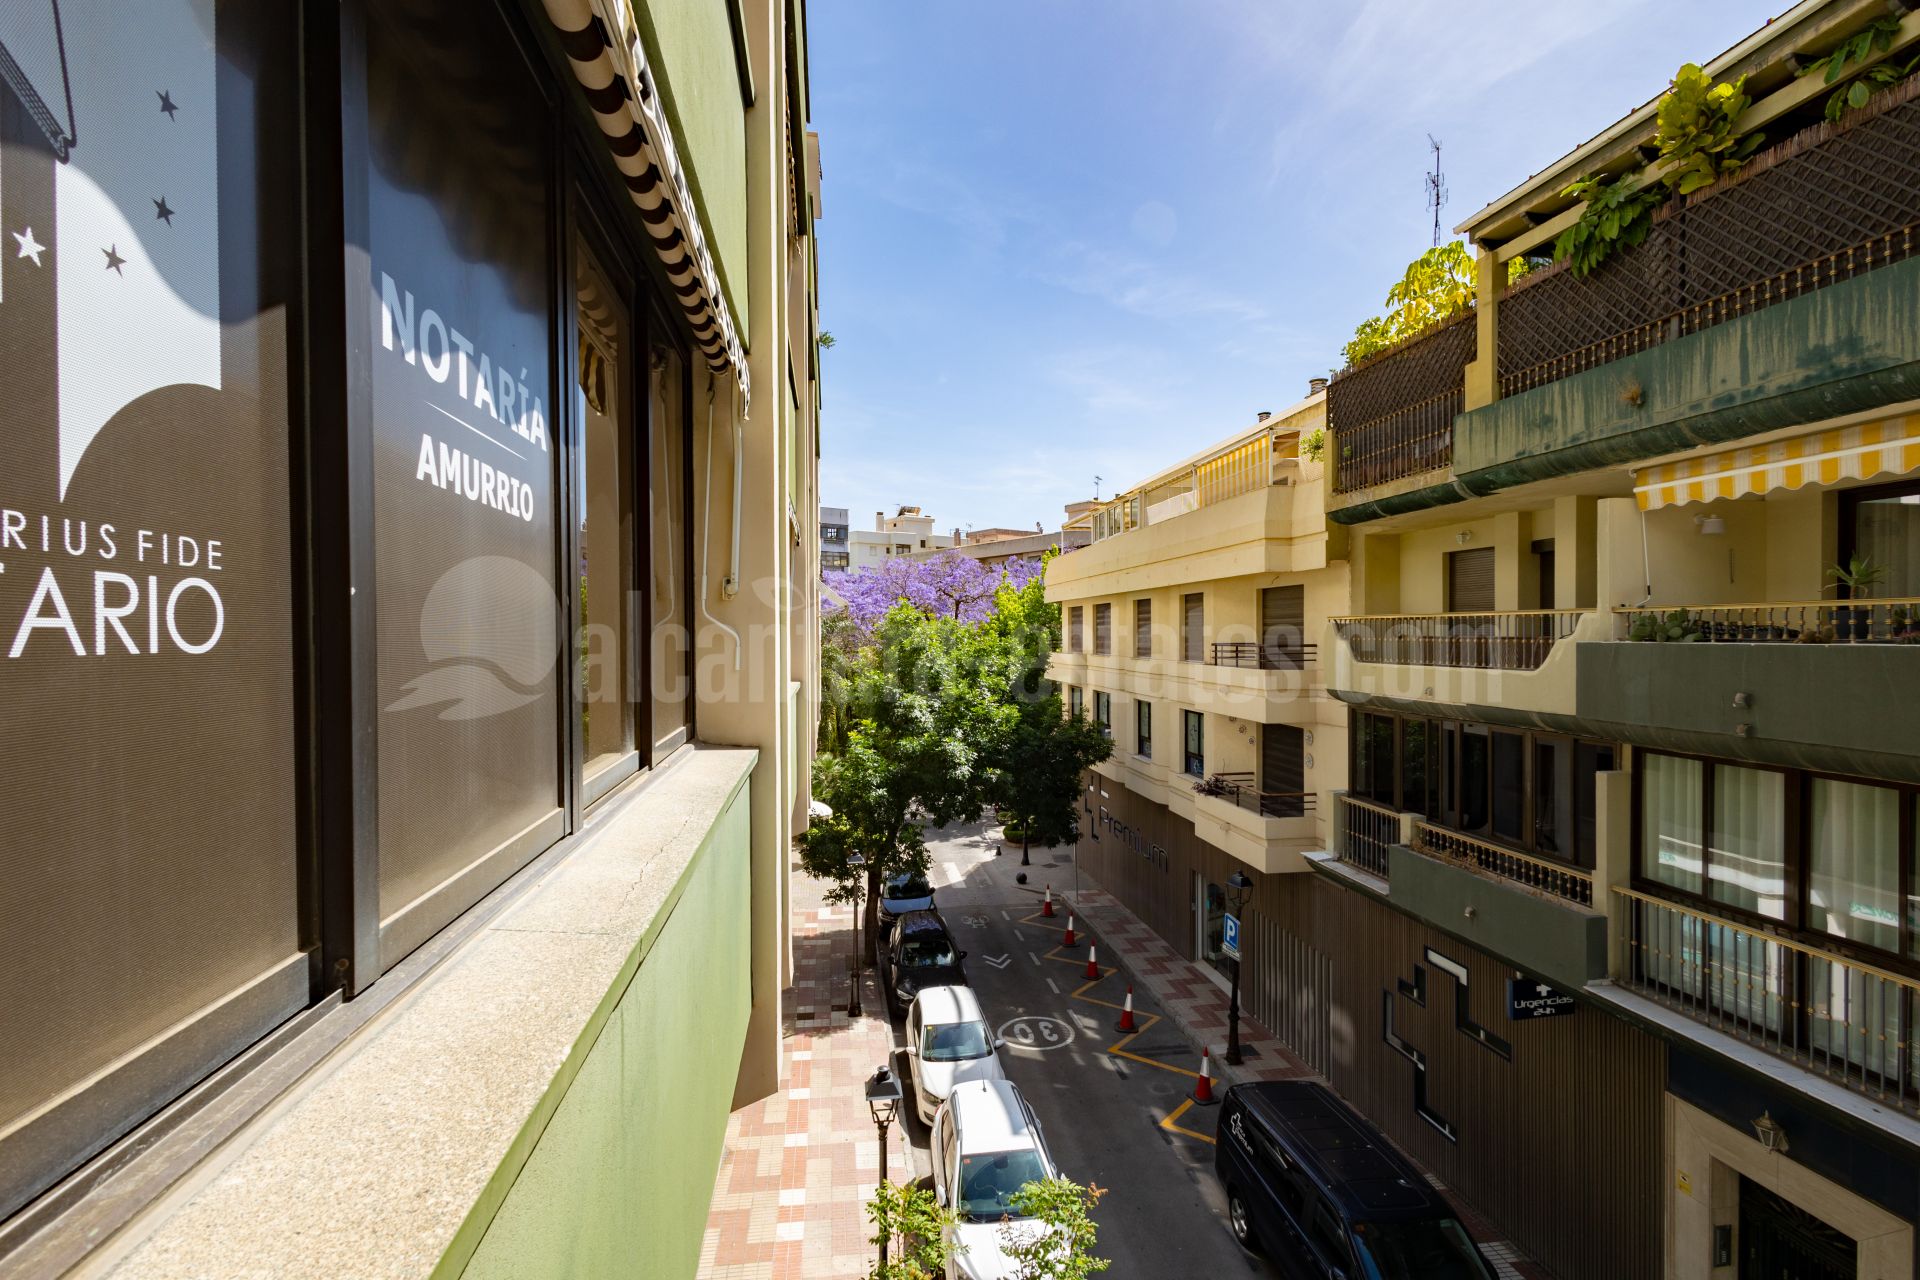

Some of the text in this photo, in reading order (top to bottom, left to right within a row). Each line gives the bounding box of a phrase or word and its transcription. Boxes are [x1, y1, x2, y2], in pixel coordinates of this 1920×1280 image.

[381, 271, 548, 452] NOTARÍA
[416, 433, 534, 522] AMURRIO
[138, 529, 222, 570] FIDE
[0, 562, 224, 658] ARIO
[1099, 805, 1169, 873] Premium
[1226, 918, 1236, 942] P
[1514, 995, 1574, 1009] Urgencias
[1533, 1007, 1556, 1016] 24h
[1013, 1021, 1059, 1044] 30
